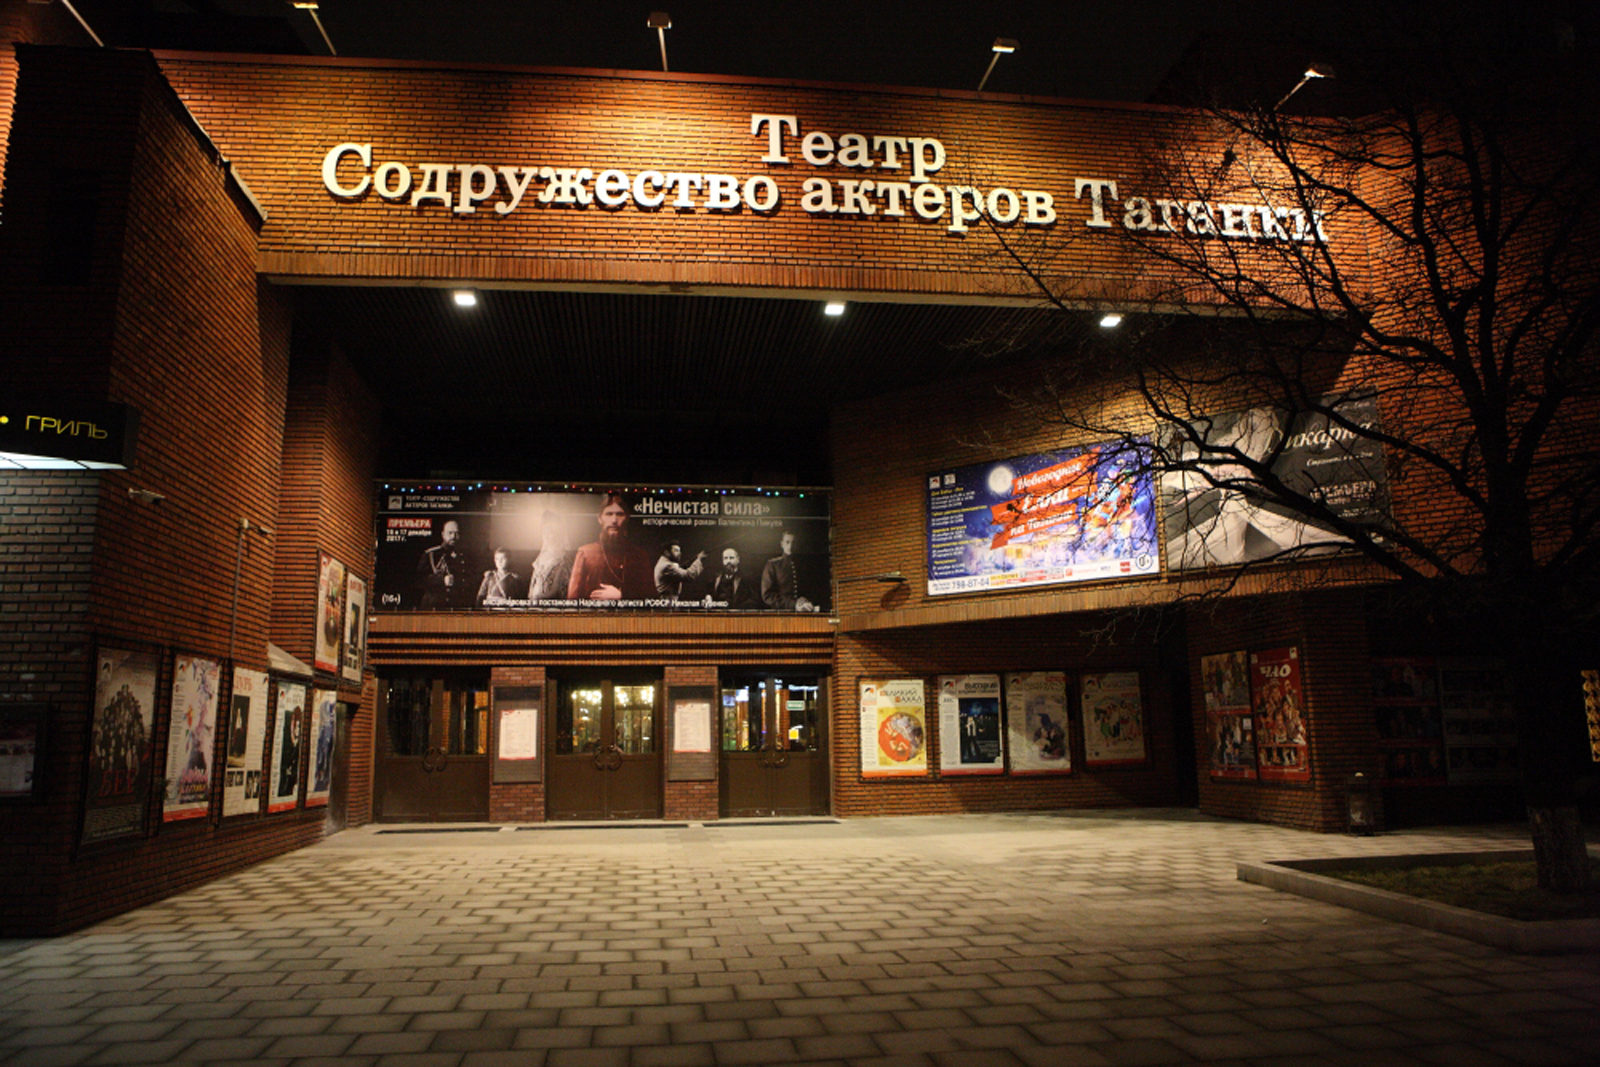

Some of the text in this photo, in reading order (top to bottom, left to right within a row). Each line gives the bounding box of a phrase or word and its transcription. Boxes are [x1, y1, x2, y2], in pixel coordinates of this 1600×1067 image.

[751, 113, 947, 182] Театр
[321, 142, 1328, 242] Содружество актеров Таганки
[25, 415, 108, 439] ГРИЛЬ
[634, 497, 770, 516] «Нечистая сила»
